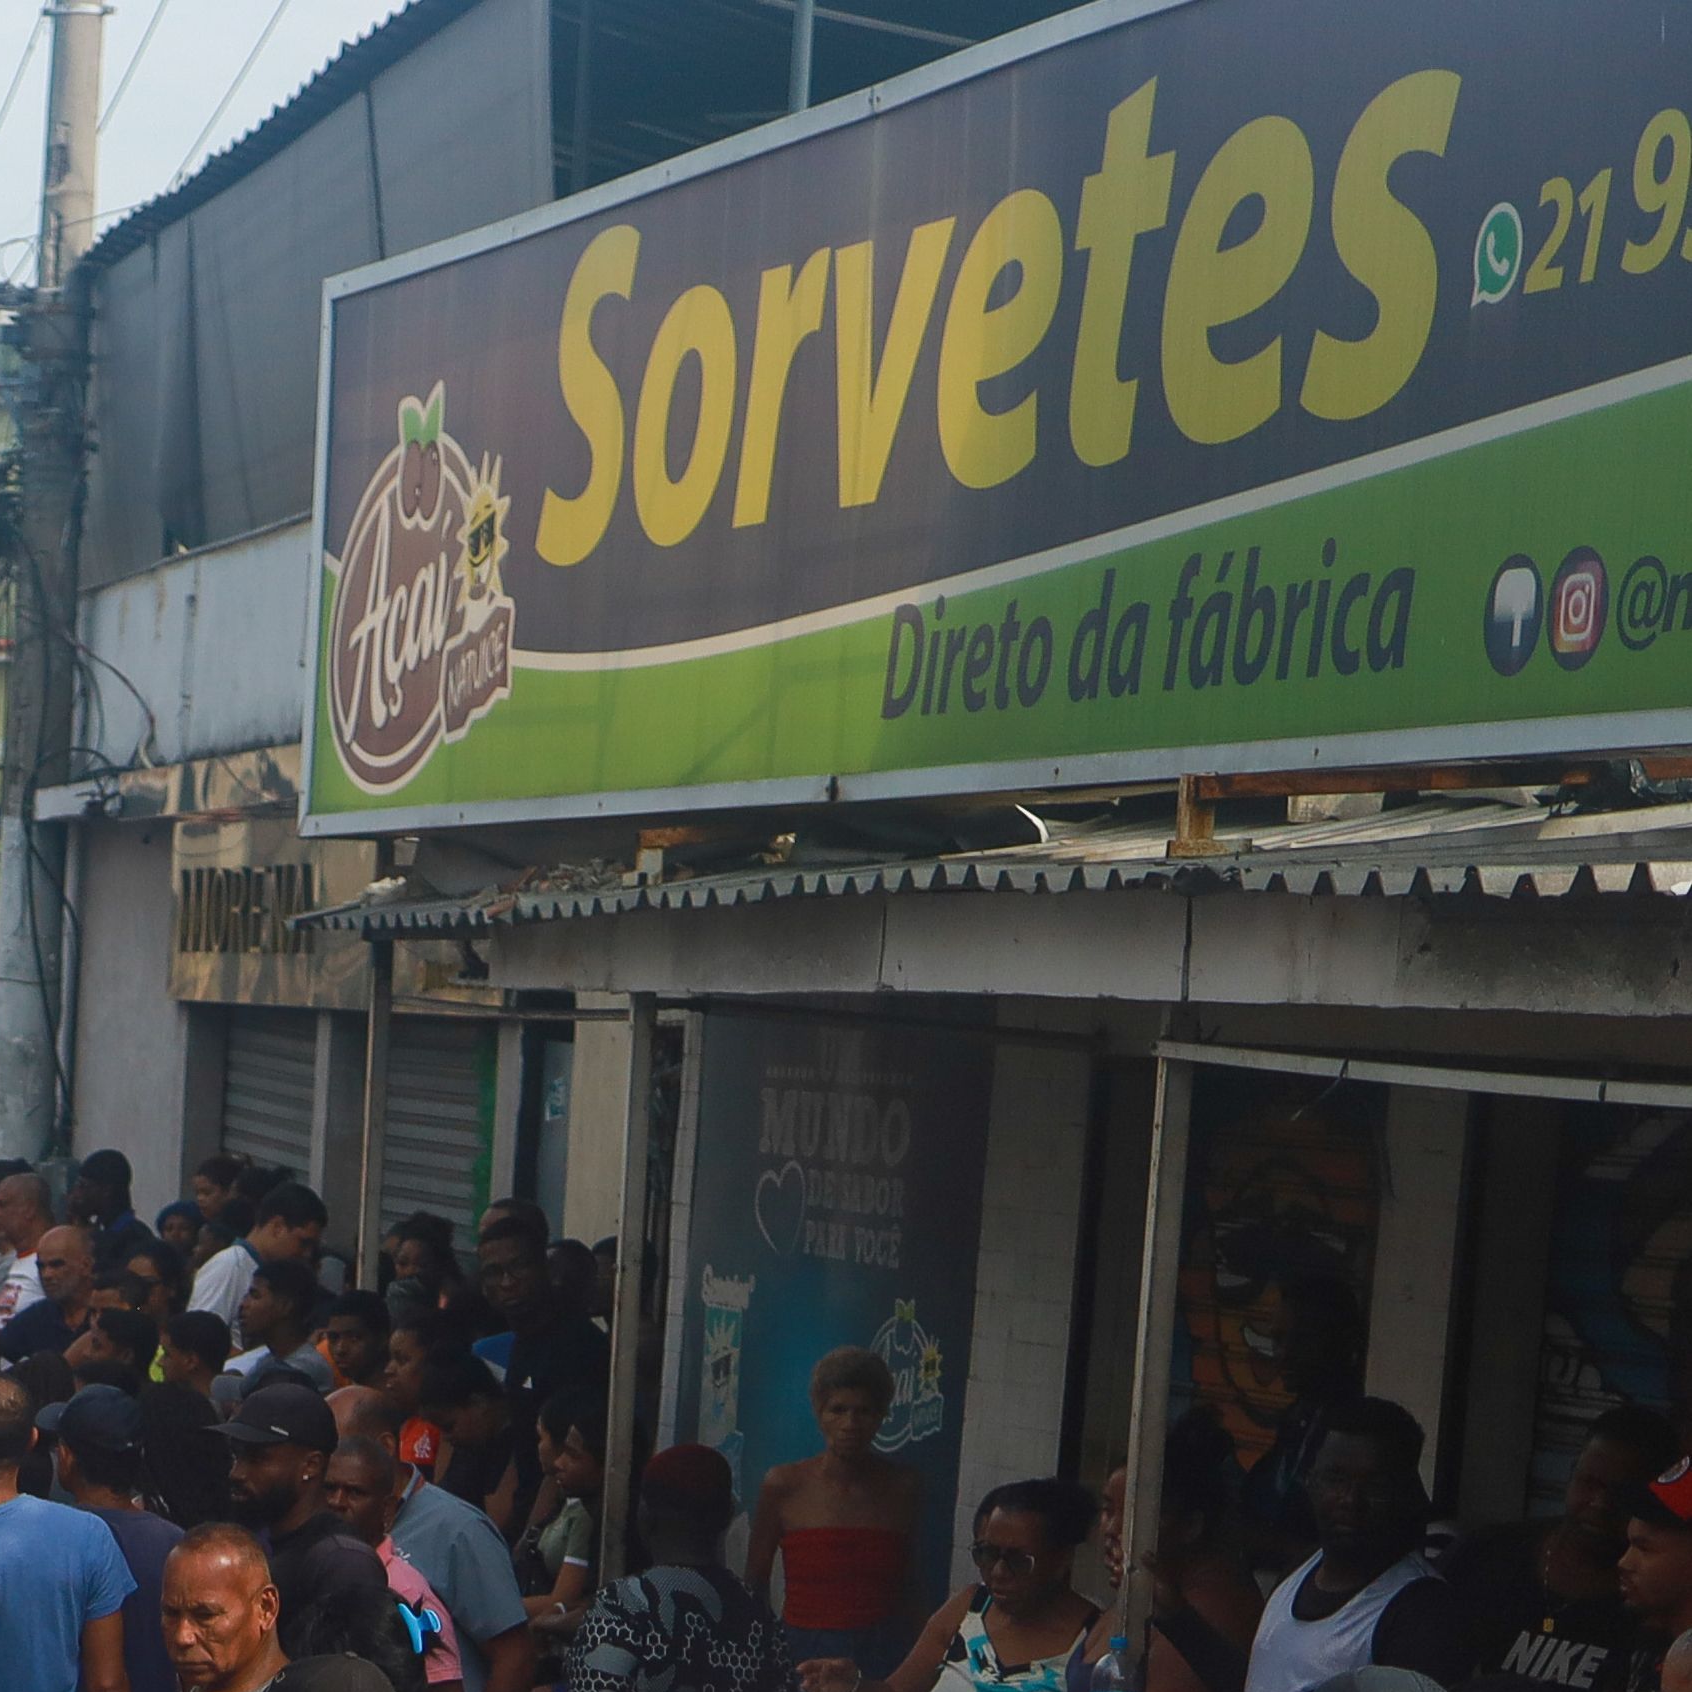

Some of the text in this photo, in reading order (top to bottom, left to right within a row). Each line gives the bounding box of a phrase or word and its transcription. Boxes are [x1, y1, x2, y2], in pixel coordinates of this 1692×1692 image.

[1523, 108, 1692, 294] 21 9
[534, 69, 1462, 567] Sorvetes
[344, 496, 452, 743] Açaí
[880, 537, 1416, 720] Direto da fábrica
[759, 1087, 911, 1166] MUNDO
[855, 1222, 903, 1269] VOCÊ
[1501, 1631, 1608, 1689] NIKE
